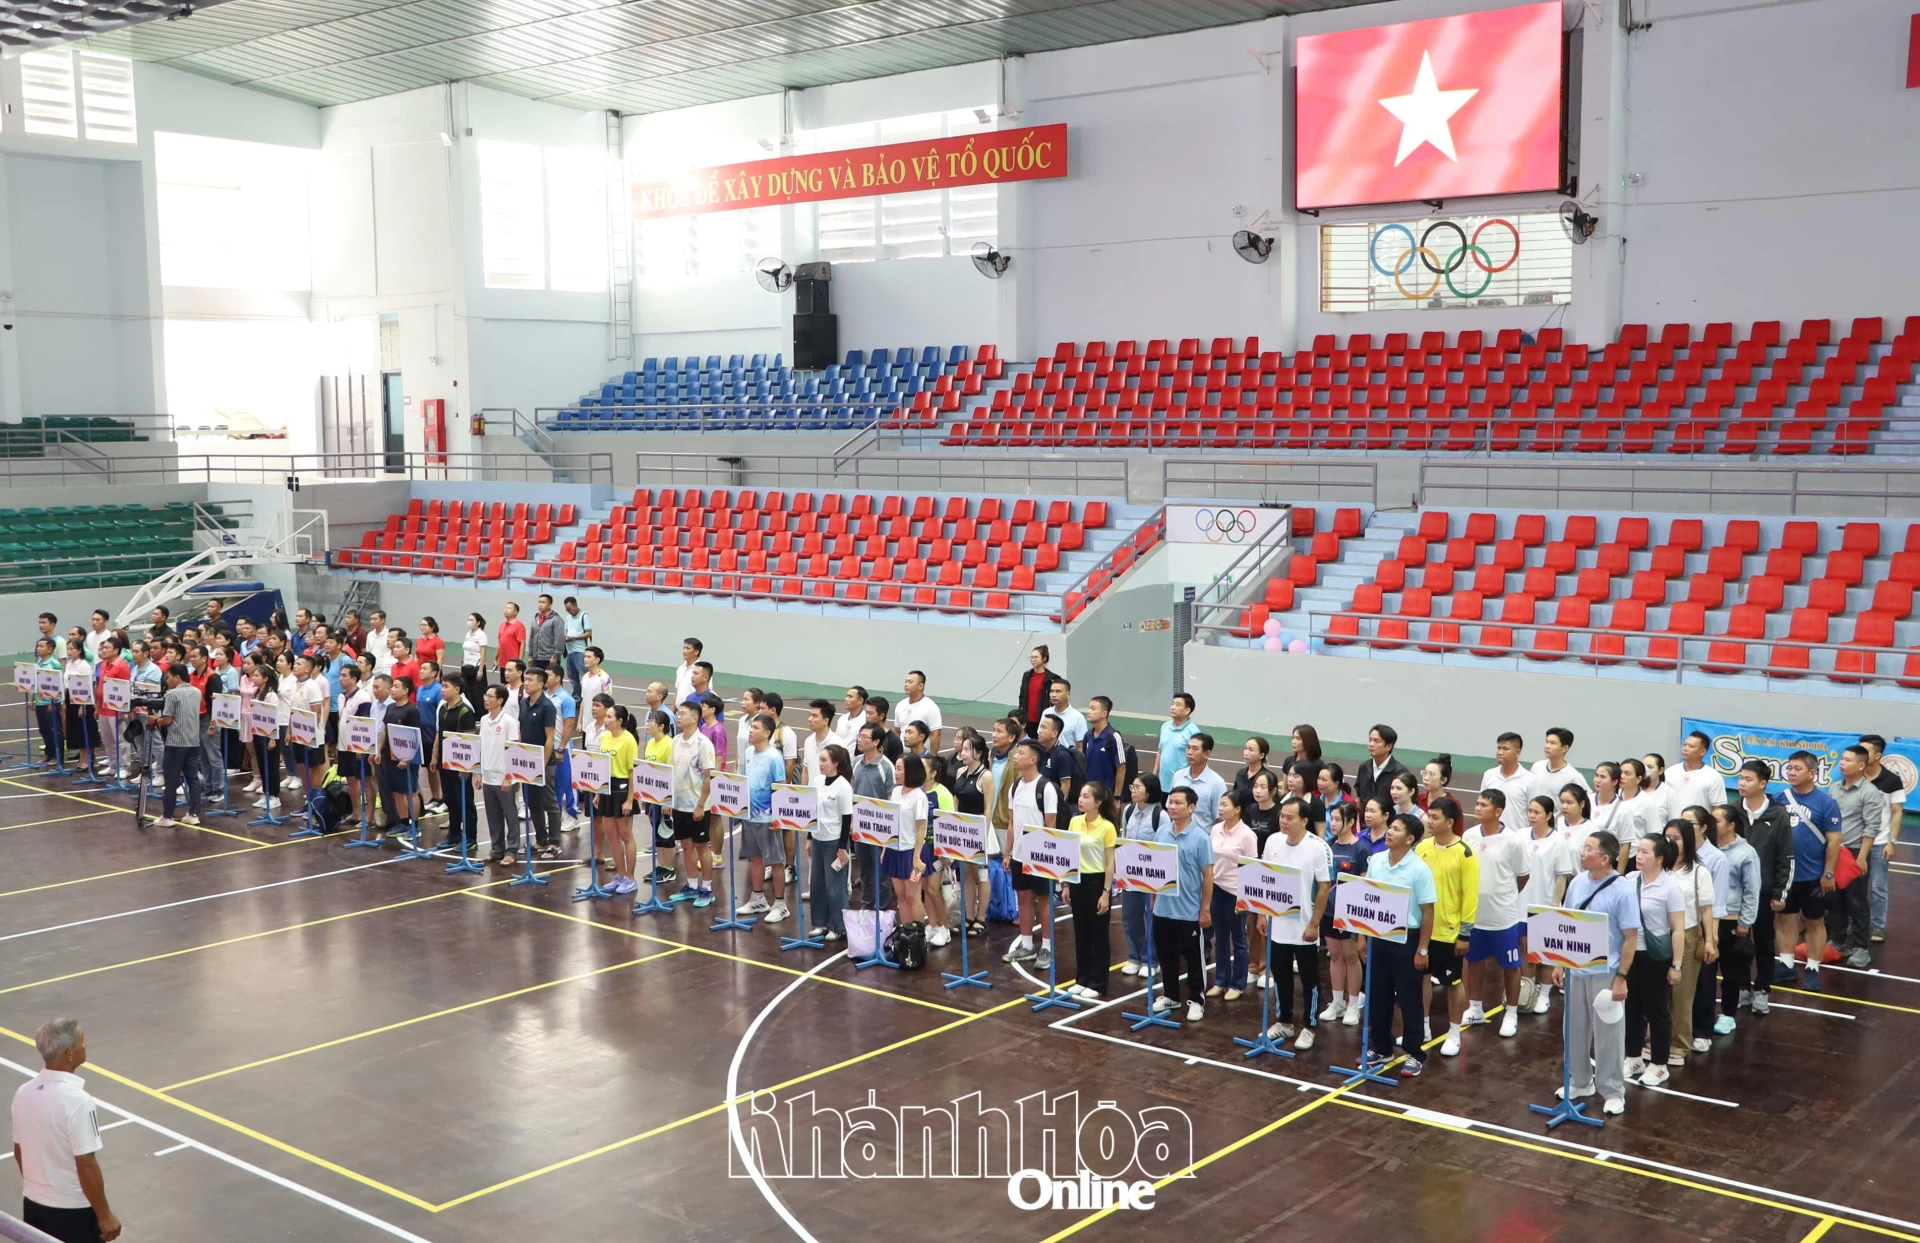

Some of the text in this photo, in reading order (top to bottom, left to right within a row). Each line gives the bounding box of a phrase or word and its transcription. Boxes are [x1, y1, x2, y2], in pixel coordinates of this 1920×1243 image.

[723, 170, 763, 202] XÂY
[768, 167, 823, 201] DỰNG
[829, 157, 857, 190] VÀ
[861, 152, 906, 187] BẢO
[911, 147, 941, 187] VỆ
[945, 138, 977, 178] TỔ
[983, 131, 1052, 180] QUỐC
[720, 794, 738, 805] MOTIVE
[789, 796, 799, 805] CỤM
[779, 808, 810, 818] PHAN RANG
[885, 812, 894, 821] HỌC
[859, 820, 892, 834] NHA TRANG
[969, 826, 979, 836] HỌC
[936, 833, 983, 850] TÔN ĐỨC THẮNG
[1044, 841, 1056, 850] CỤM
[1030, 851, 1070, 867] KHÁNH SƠN
[1139, 853, 1152, 863] CỤM
[1126, 865, 1166, 879] CAM RANH
[1261, 875, 1276, 886] CỤM
[1244, 885, 1293, 904] NINH PHƯỚC
[1364, 893, 1380, 904] CỤM
[1346, 904, 1396, 924] THUẬN BẮC
[1558, 924, 1576, 935] CỤM
[1544, 937, 1591, 954] VẠN NINH
[1507, 948, 1519, 962] 10
